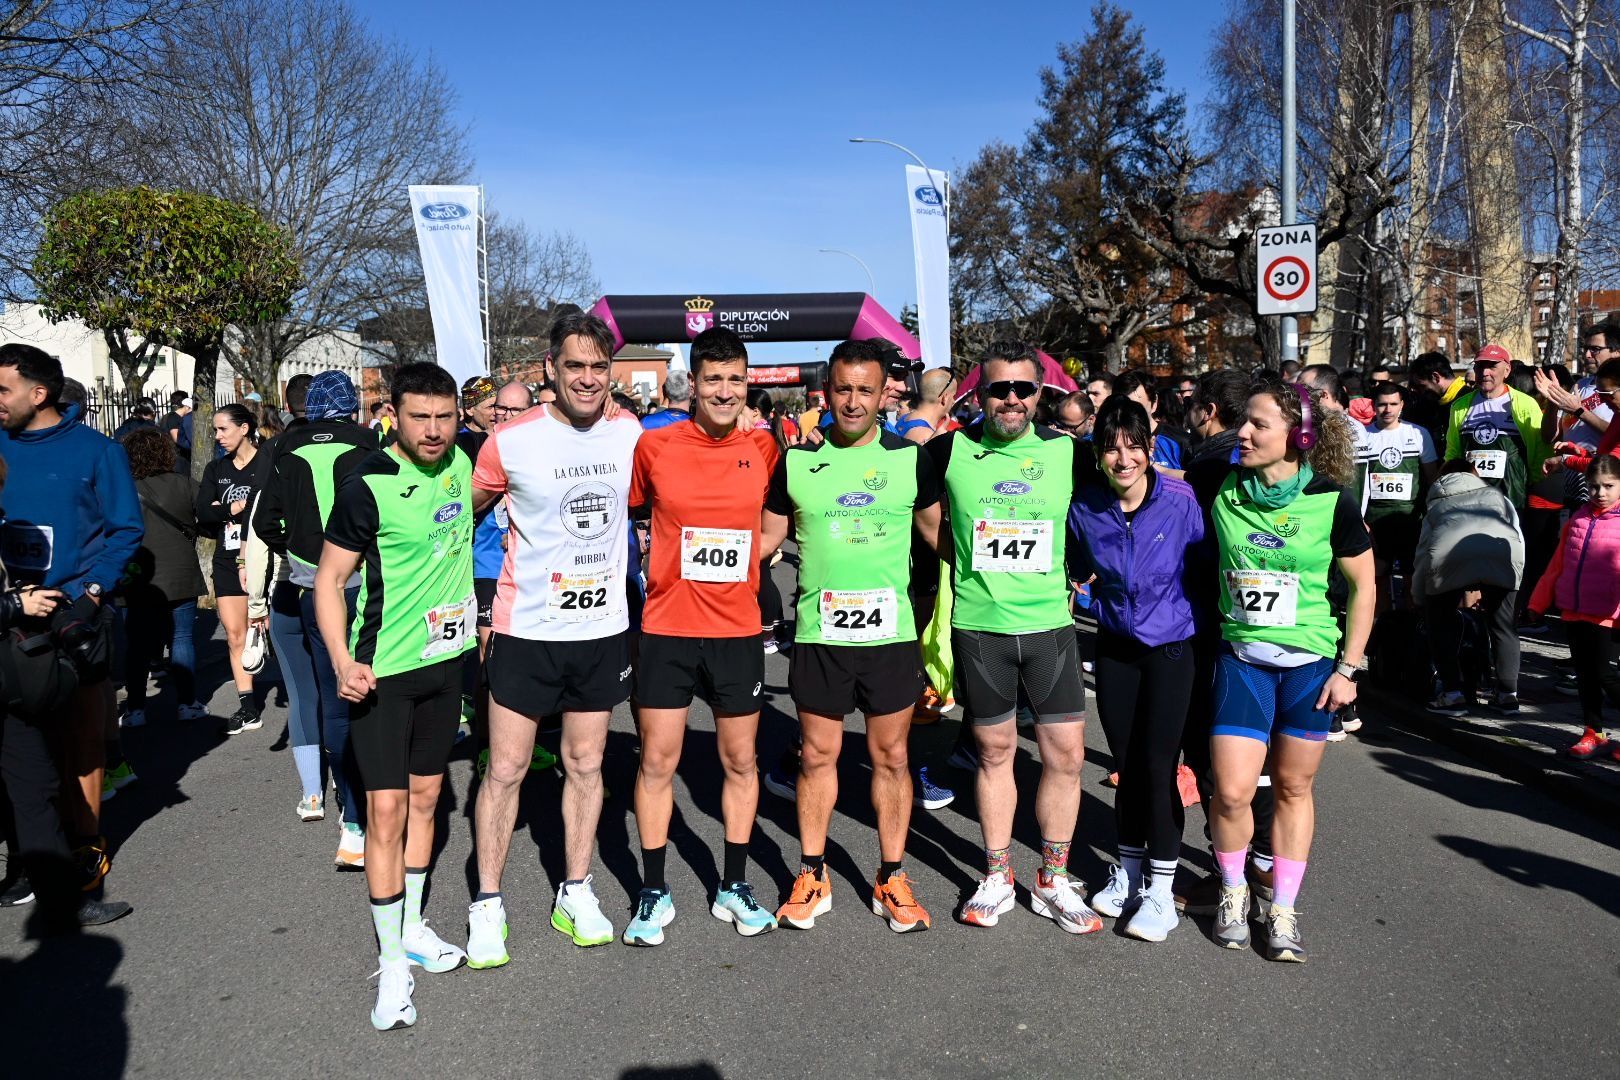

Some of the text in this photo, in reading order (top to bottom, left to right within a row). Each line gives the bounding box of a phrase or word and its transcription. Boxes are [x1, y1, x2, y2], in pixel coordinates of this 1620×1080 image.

[1261, 230, 1312, 246] ZONA
[1274, 271, 1299, 286] 30
[720, 308, 789, 322] DIPUTACIÓN
[737, 321, 768, 333] LEÓN
[555, 462, 618, 479] LA CASA VIEJA
[1000, 482, 1025, 493] Ford
[1377, 483, 1403, 493] 166
[844, 494, 868, 505] Ford
[978, 497, 1046, 505] AUTOPALACIOS
[440, 505, 458, 521] Ford
[824, 509, 890, 518] AUTOPALACIOS
[1253, 534, 1277, 547] Ford
[987, 539, 1036, 559] 147
[574, 552, 607, 566] BURBIA
[693, 548, 738, 567] 408
[560, 587, 607, 609] 262
[1236, 590, 1280, 612] 127
[833, 608, 883, 629] 224
[443, 617, 465, 640] 51
